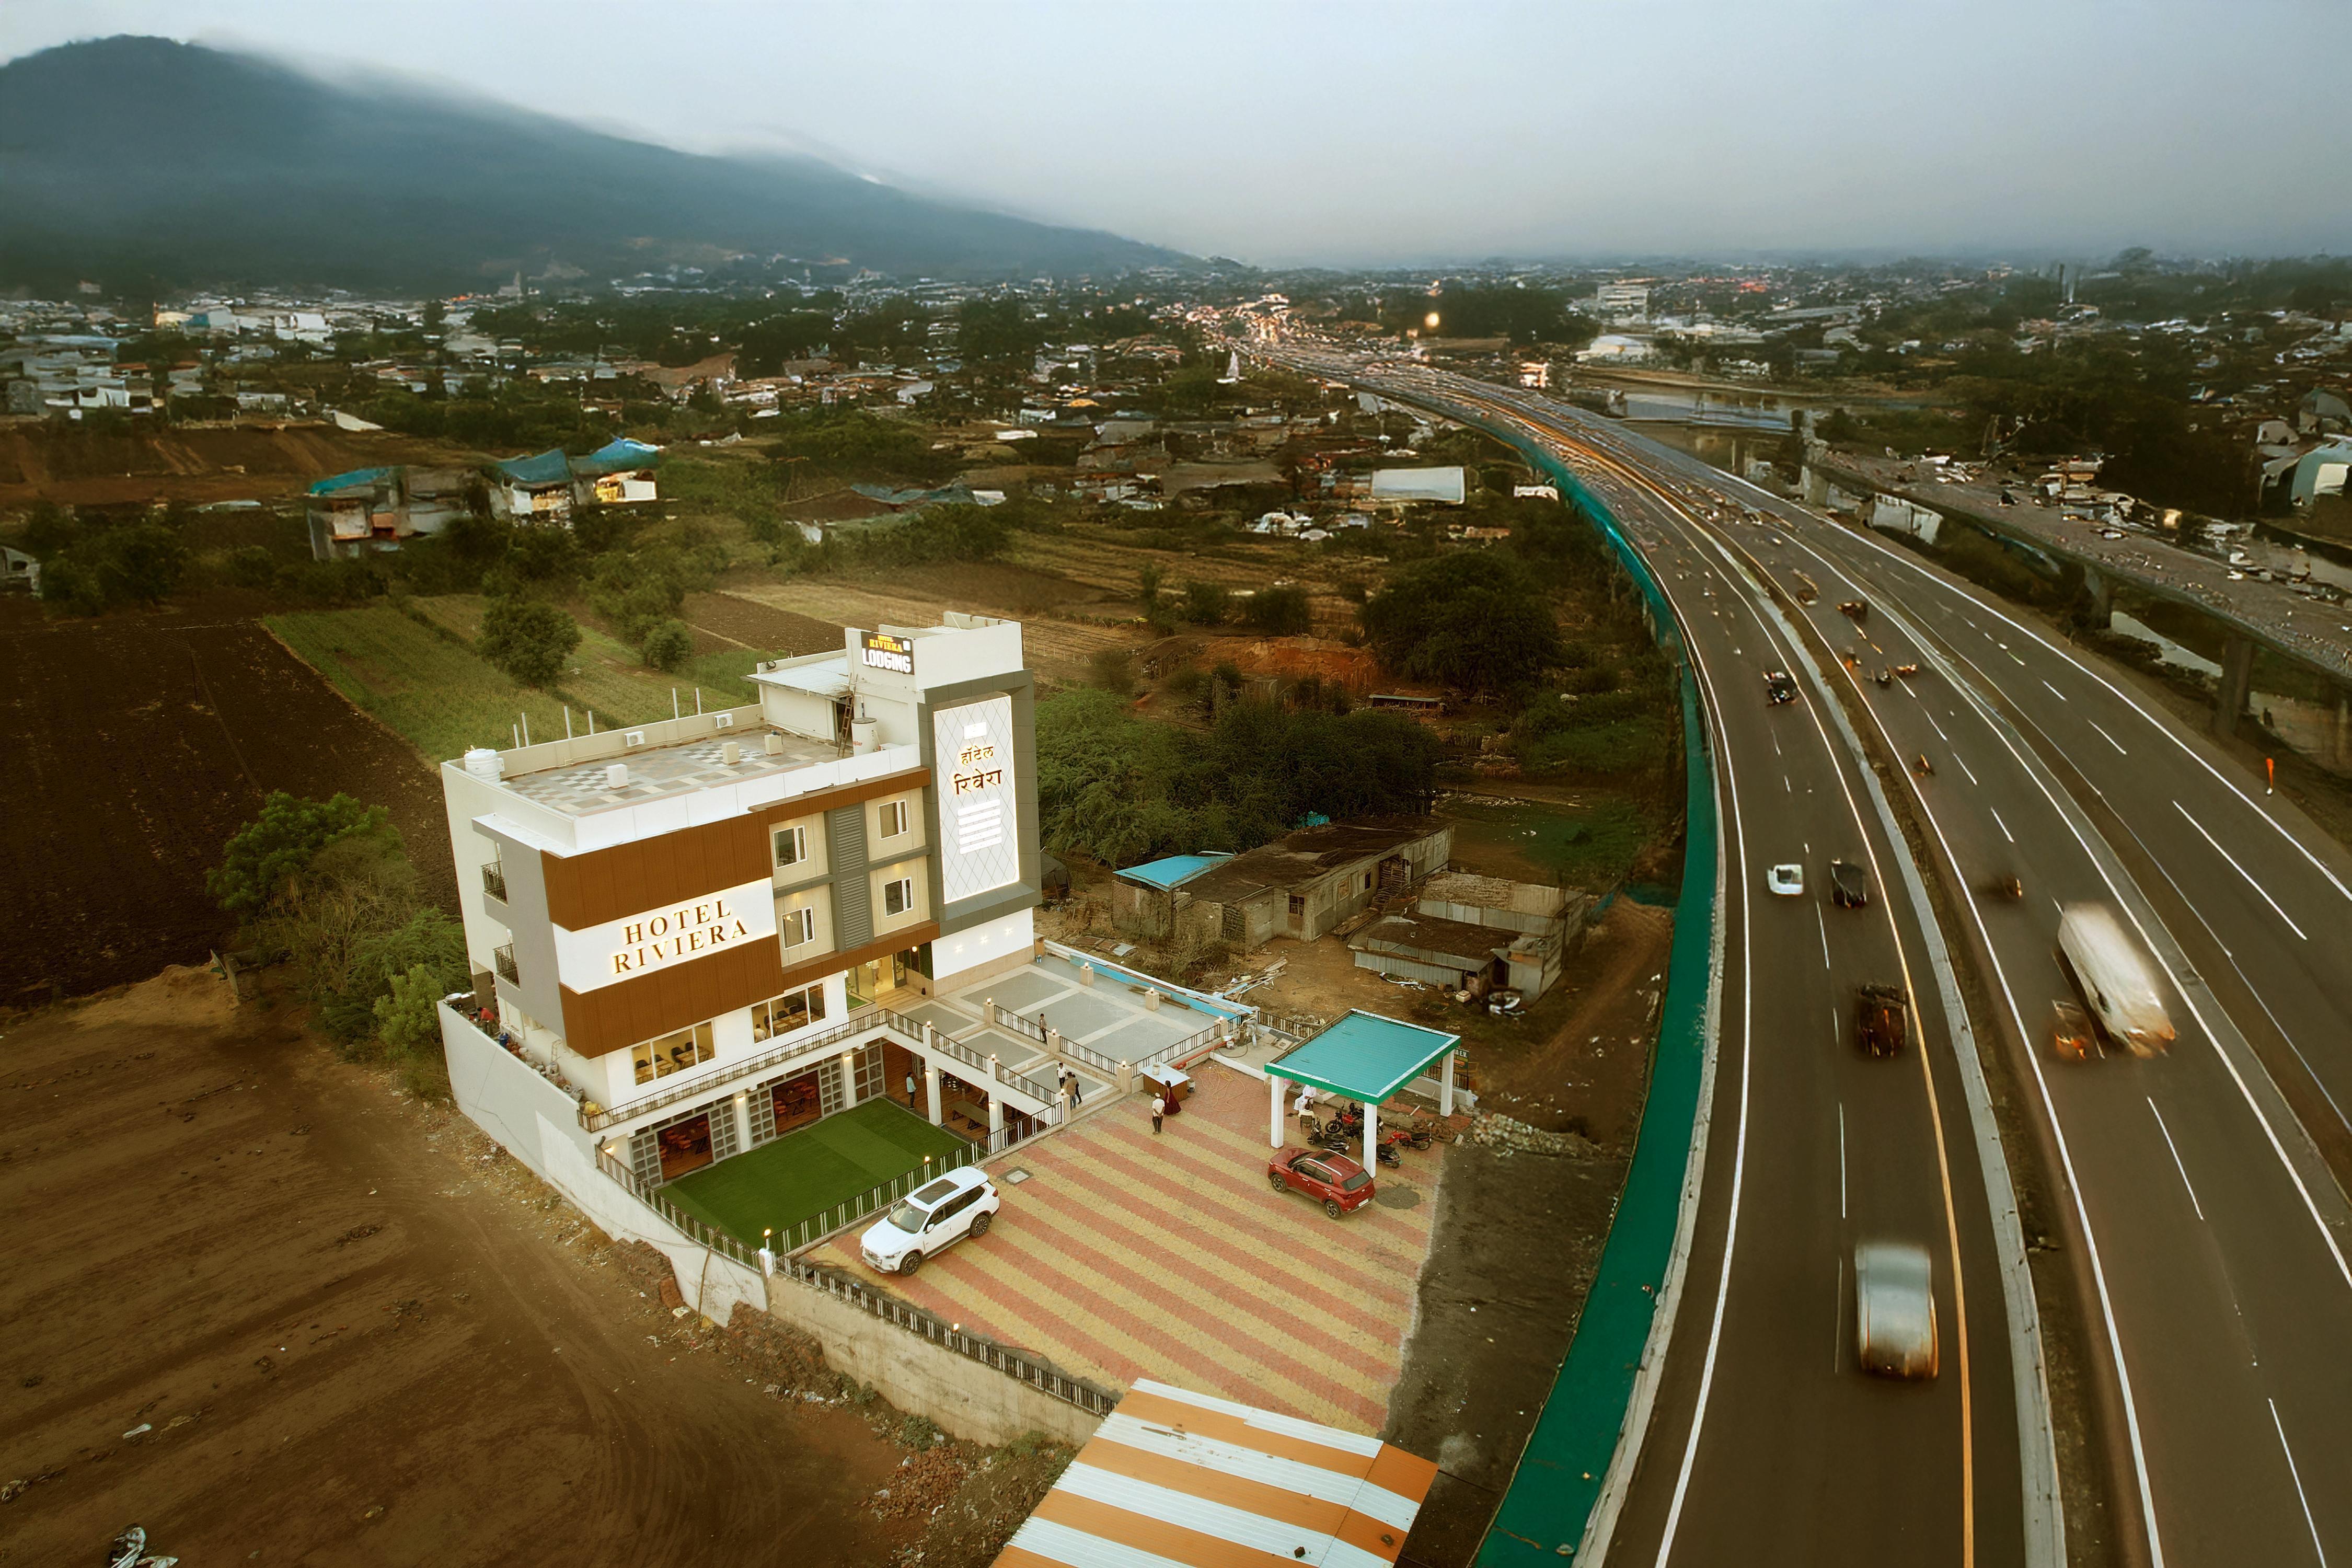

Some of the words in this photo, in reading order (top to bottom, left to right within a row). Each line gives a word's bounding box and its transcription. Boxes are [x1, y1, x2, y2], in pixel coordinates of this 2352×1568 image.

[869, 639, 903, 652] RIVIERA
[862, 648, 911, 673] LODGING
[961, 745, 994, 766] हॉटेल
[954, 768, 1002, 794] रिवेरा
[624, 900, 731, 945] HOTEL
[612, 919, 748, 974] RIVIERA
